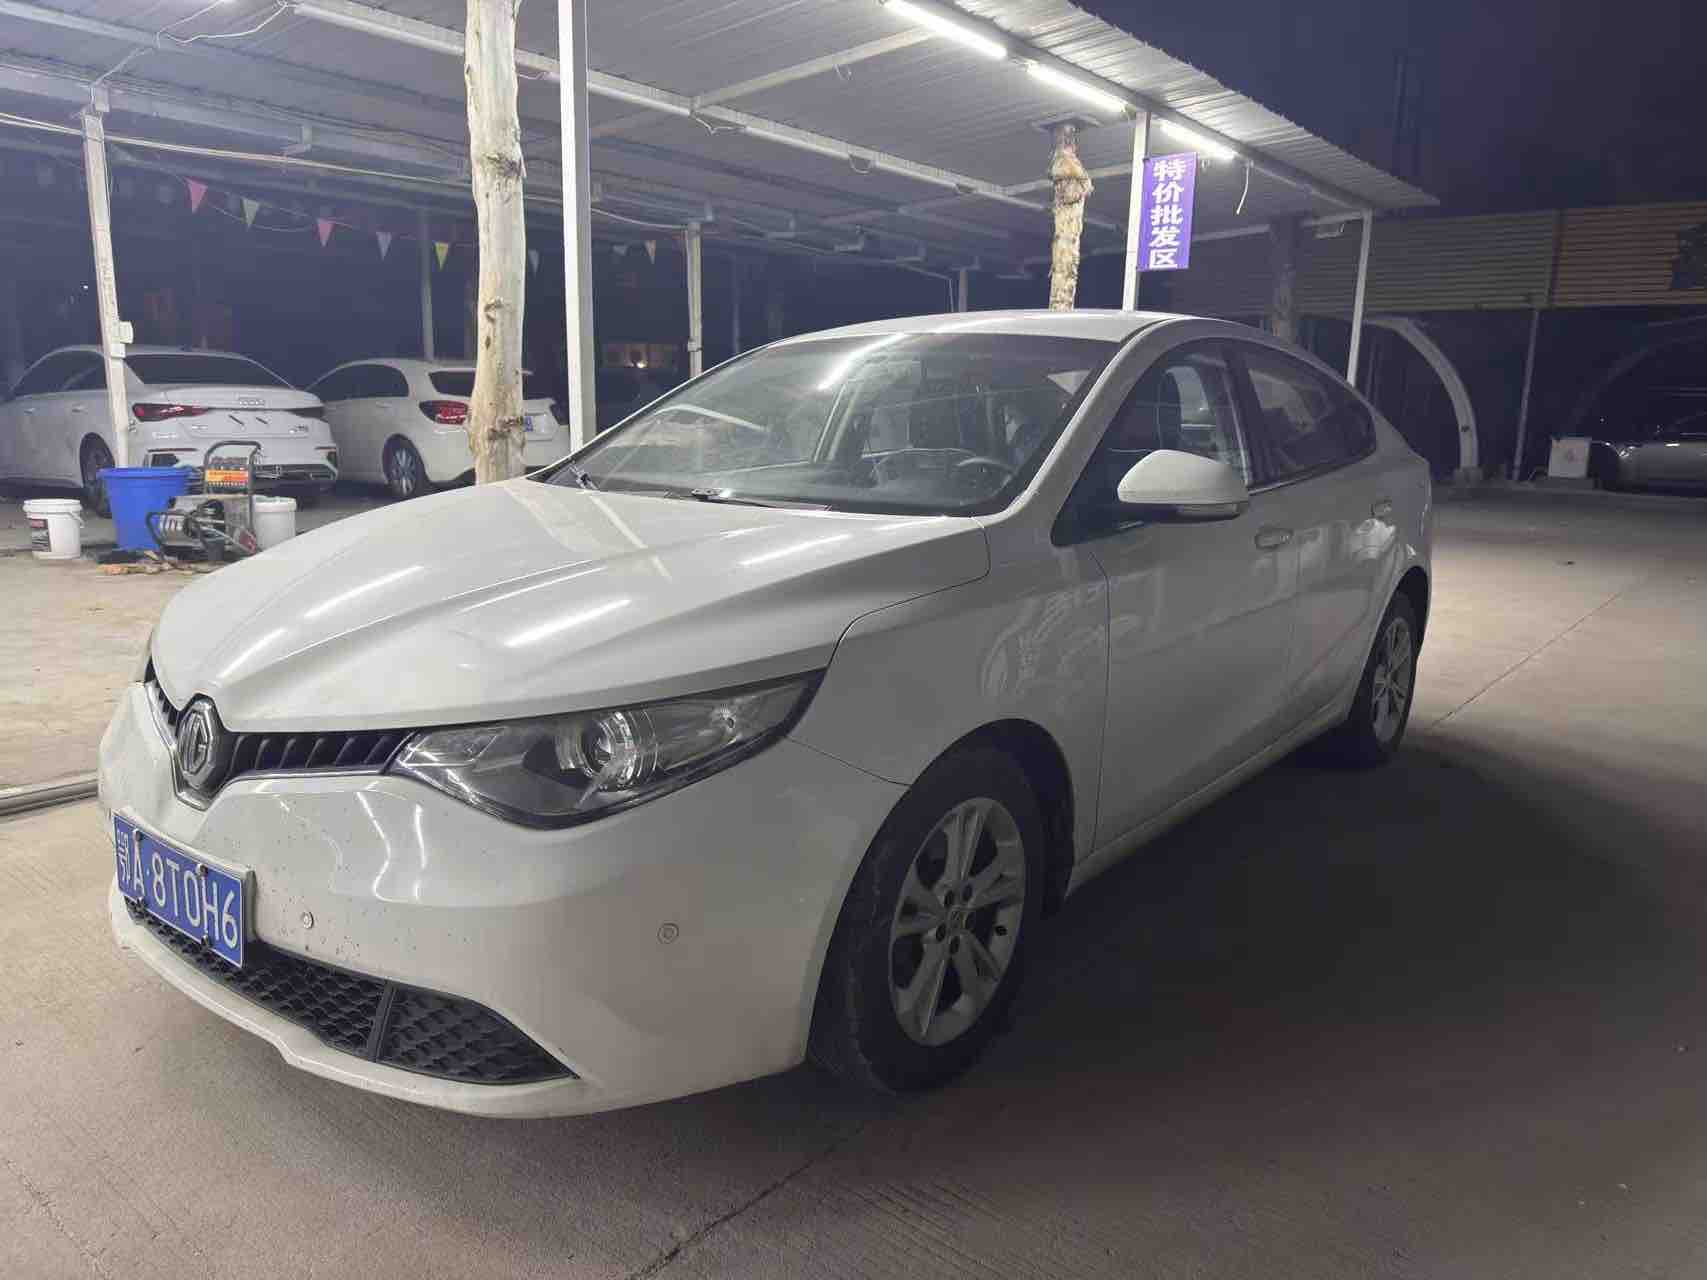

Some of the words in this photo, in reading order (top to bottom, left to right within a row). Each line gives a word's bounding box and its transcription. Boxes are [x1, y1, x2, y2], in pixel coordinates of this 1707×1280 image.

[1149, 159, 1185, 269] 特价批发区
